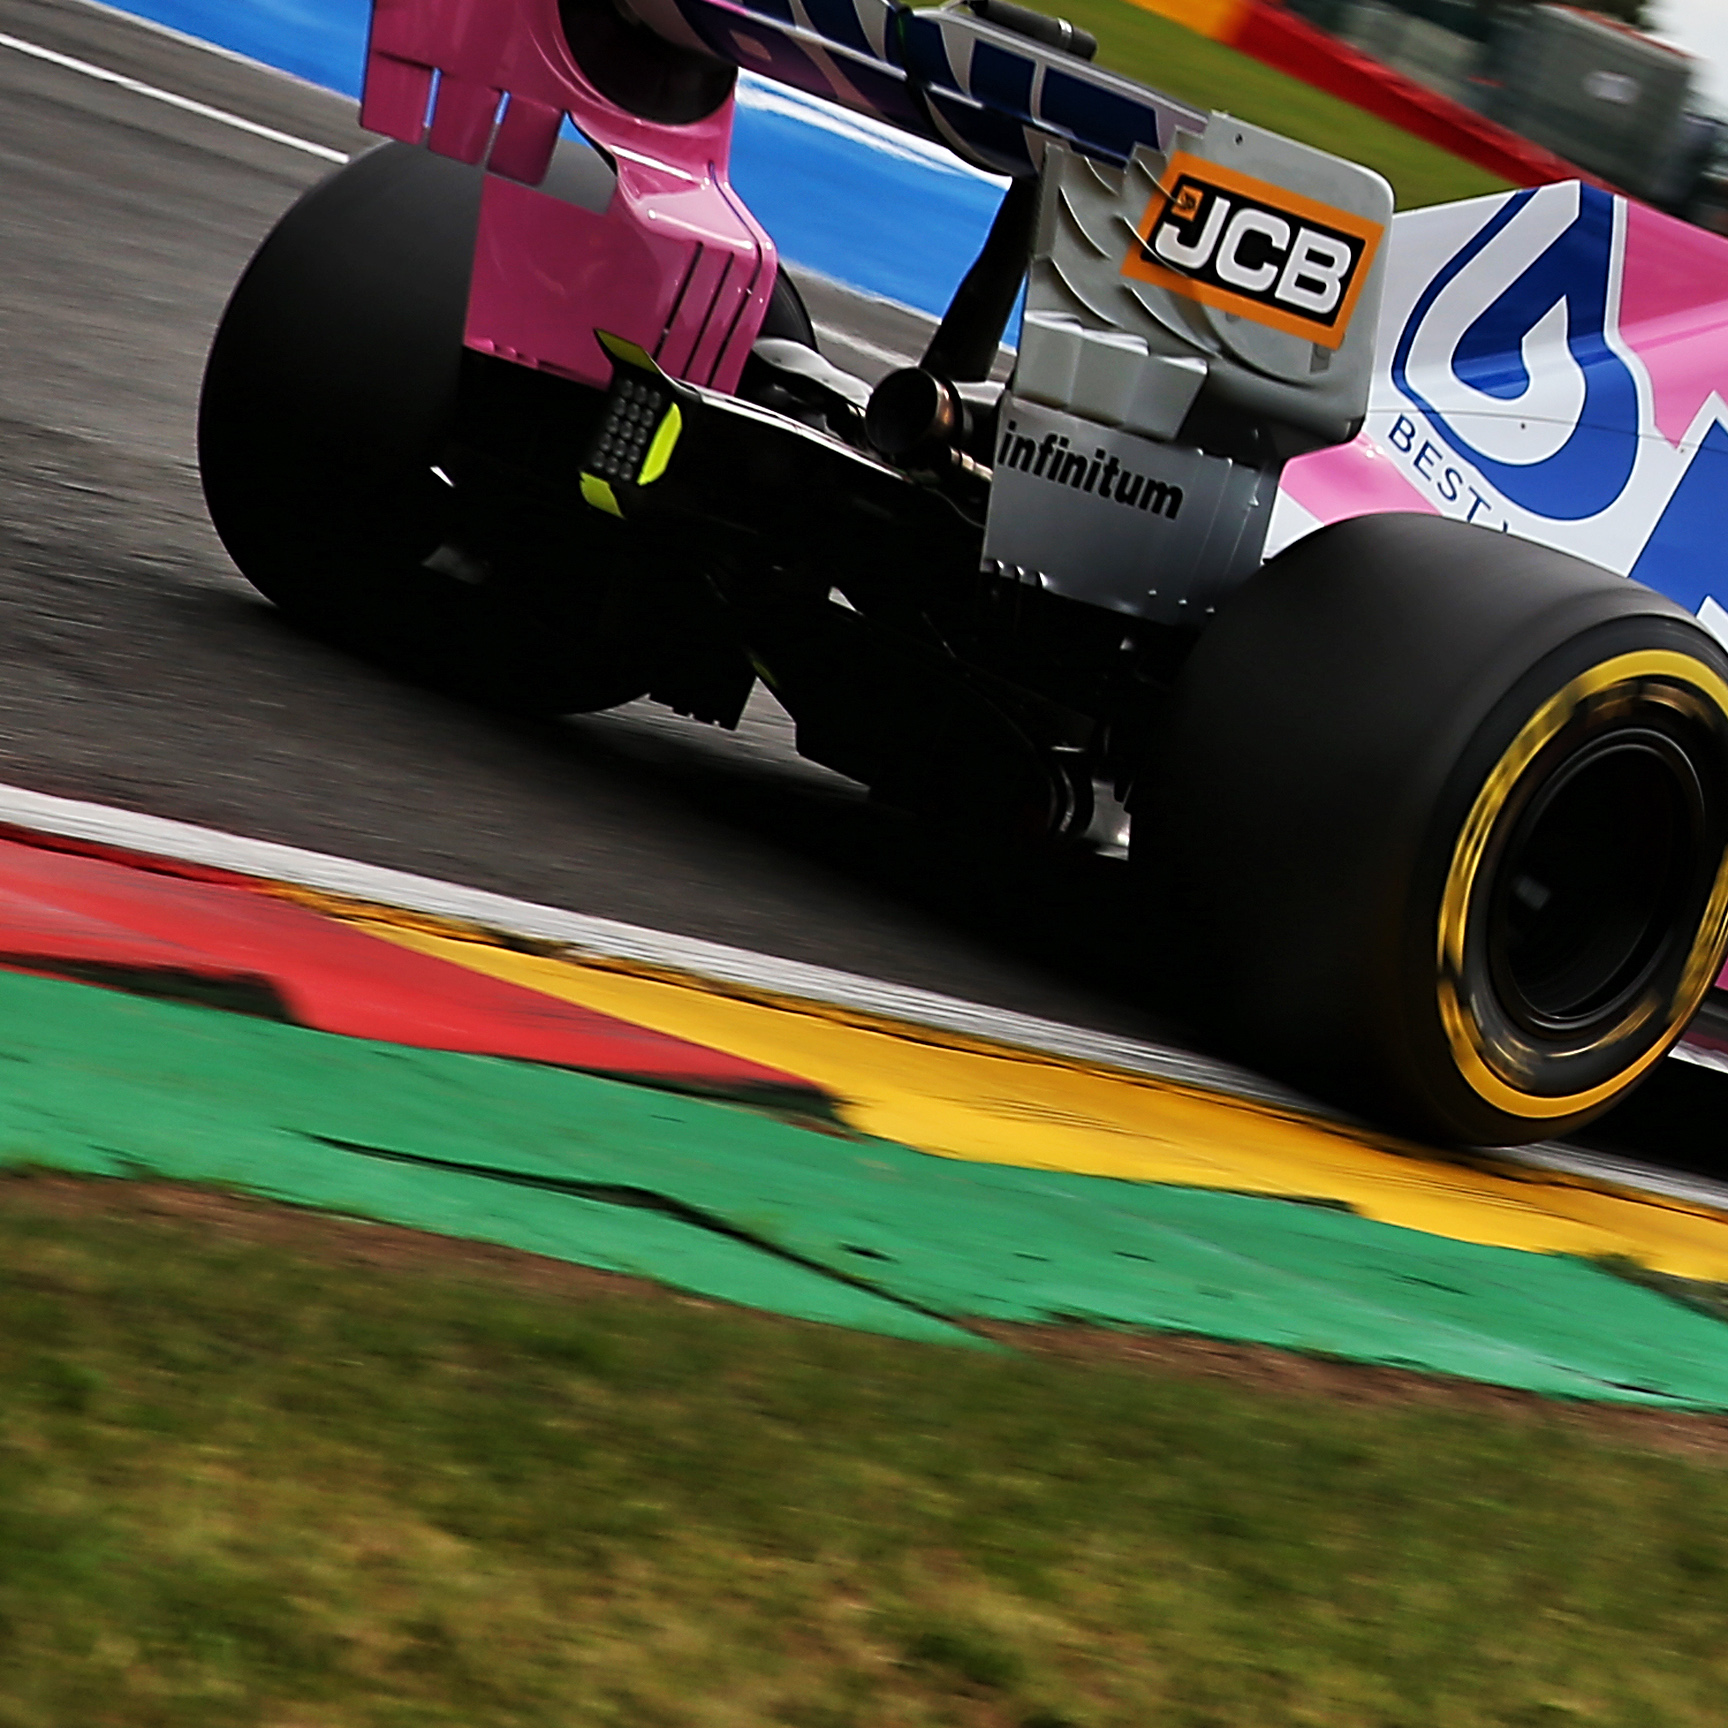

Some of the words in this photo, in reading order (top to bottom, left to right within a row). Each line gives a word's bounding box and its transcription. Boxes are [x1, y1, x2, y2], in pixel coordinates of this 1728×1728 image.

[1155, 195, 1352, 314] JCB
[997, 420, 1184, 521] infinitum
[1388, 413, 1492, 523] BEST
